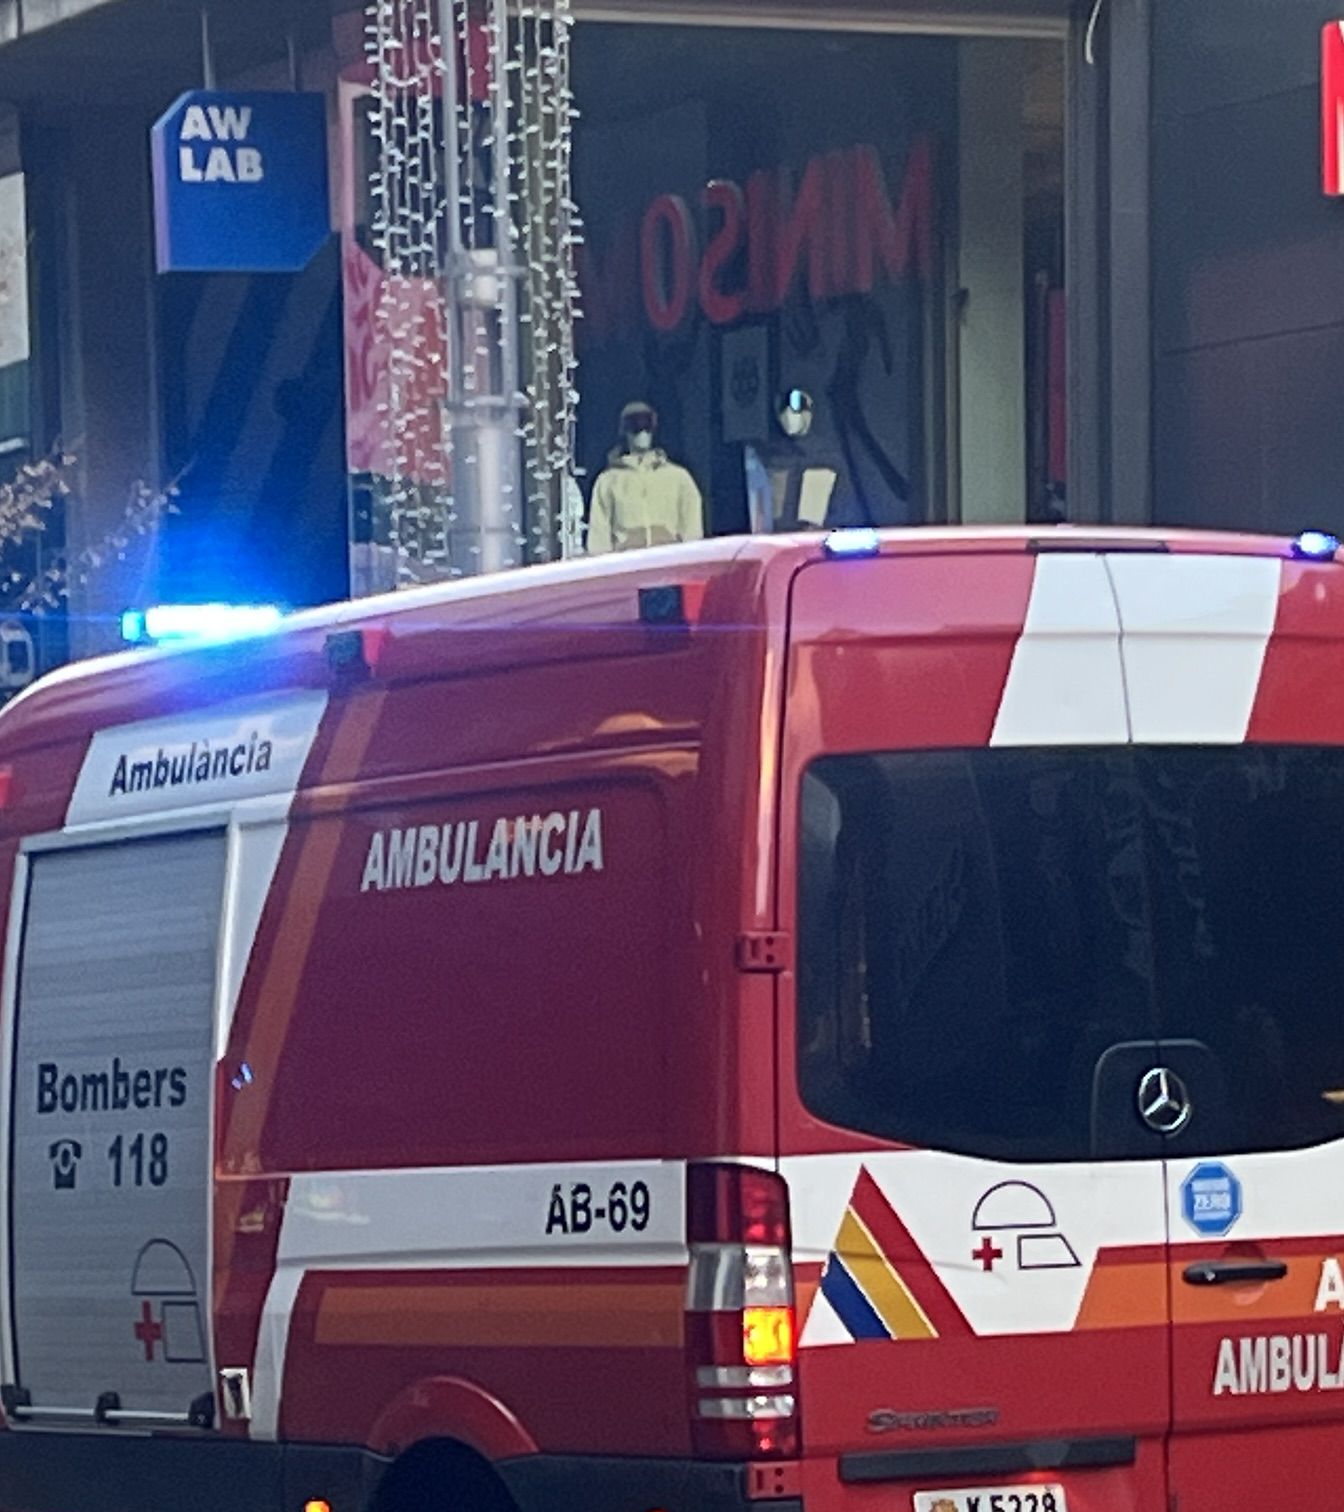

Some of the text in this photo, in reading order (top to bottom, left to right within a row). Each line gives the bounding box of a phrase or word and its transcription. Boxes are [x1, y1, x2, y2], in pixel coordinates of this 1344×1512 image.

[179, 105, 253, 141] AW
[178, 146, 264, 183] LAB
[109, 731, 273, 798] Ambulància
[359, 808, 604, 893] AMBULANCIA
[37, 1057, 187, 1114] Bombers
[107, 1132, 169, 1187] 118
[545, 1180, 650, 1235] AB-69
